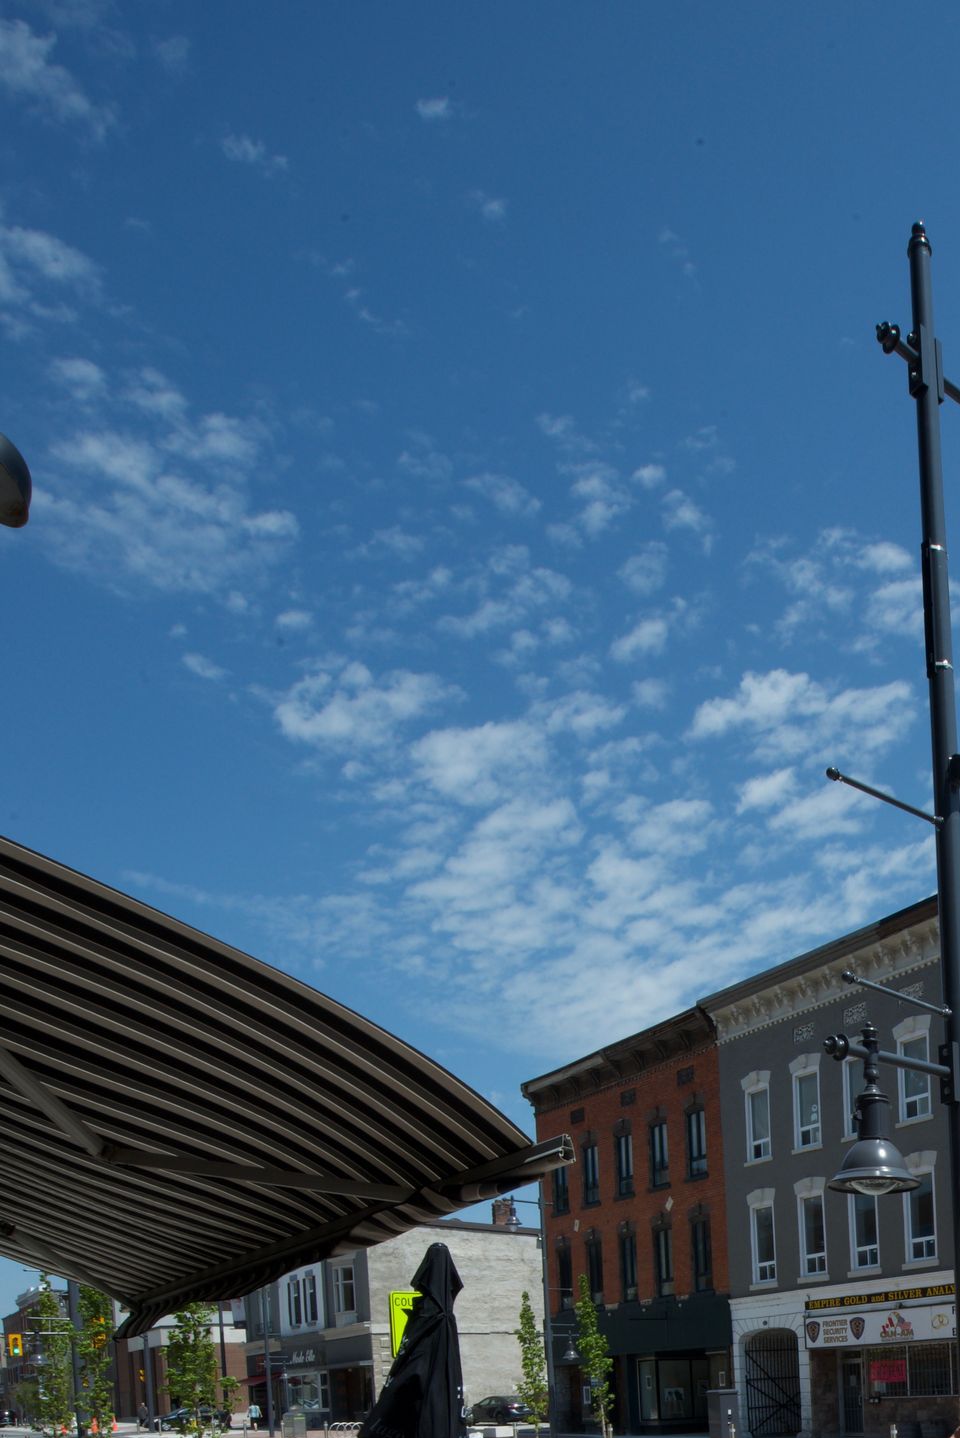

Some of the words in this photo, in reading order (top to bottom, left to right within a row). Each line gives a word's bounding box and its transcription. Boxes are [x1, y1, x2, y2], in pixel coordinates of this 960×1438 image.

[808, 1299, 841, 1310] EMPIRE
[843, 1295, 868, 1306] GOLD
[870, 1293, 885, 1303] and
[887, 1288, 922, 1302] SILVER
[926, 1283, 956, 1296] ANALY
[822, 1319, 848, 1328] FRONTIER
[822, 1327, 848, 1336] SECURITY
[823, 1335, 848, 1344] SERVICES
